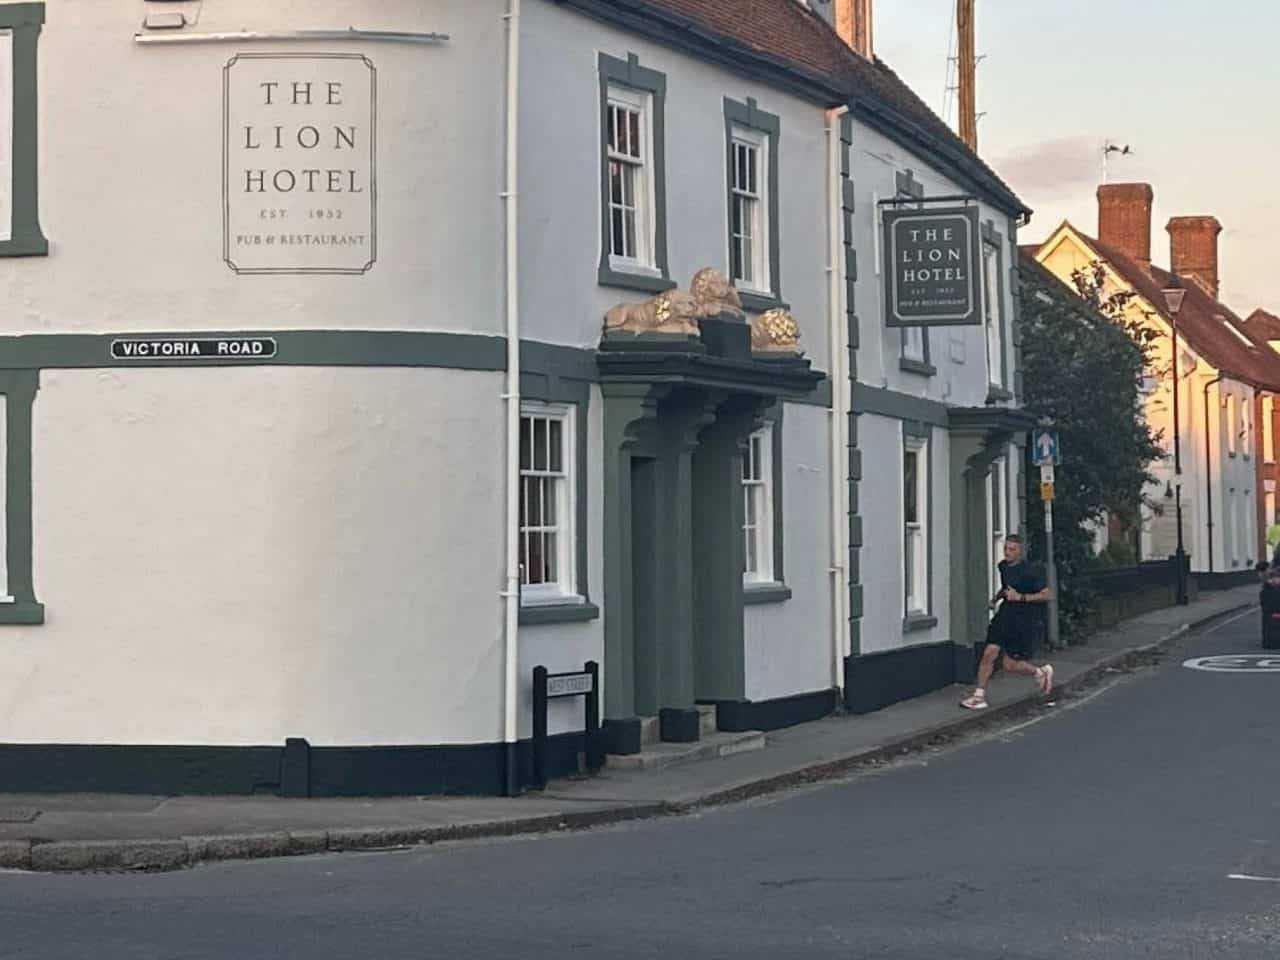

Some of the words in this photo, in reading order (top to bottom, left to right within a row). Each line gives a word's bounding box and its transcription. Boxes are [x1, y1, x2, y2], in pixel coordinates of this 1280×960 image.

[260, 82, 343, 105] THE
[243, 126, 358, 149] LION
[244, 168, 363, 193] HOTEL
[236, 235, 262, 246] PUB
[280, 234, 366, 246] RESTAURANT
[910, 228, 953, 242] THE
[903, 248, 961, 263] LION
[903, 267, 966, 282] HOTEL
[122, 342, 200, 356] VICTORIA
[218, 341, 263, 355] ROAD
